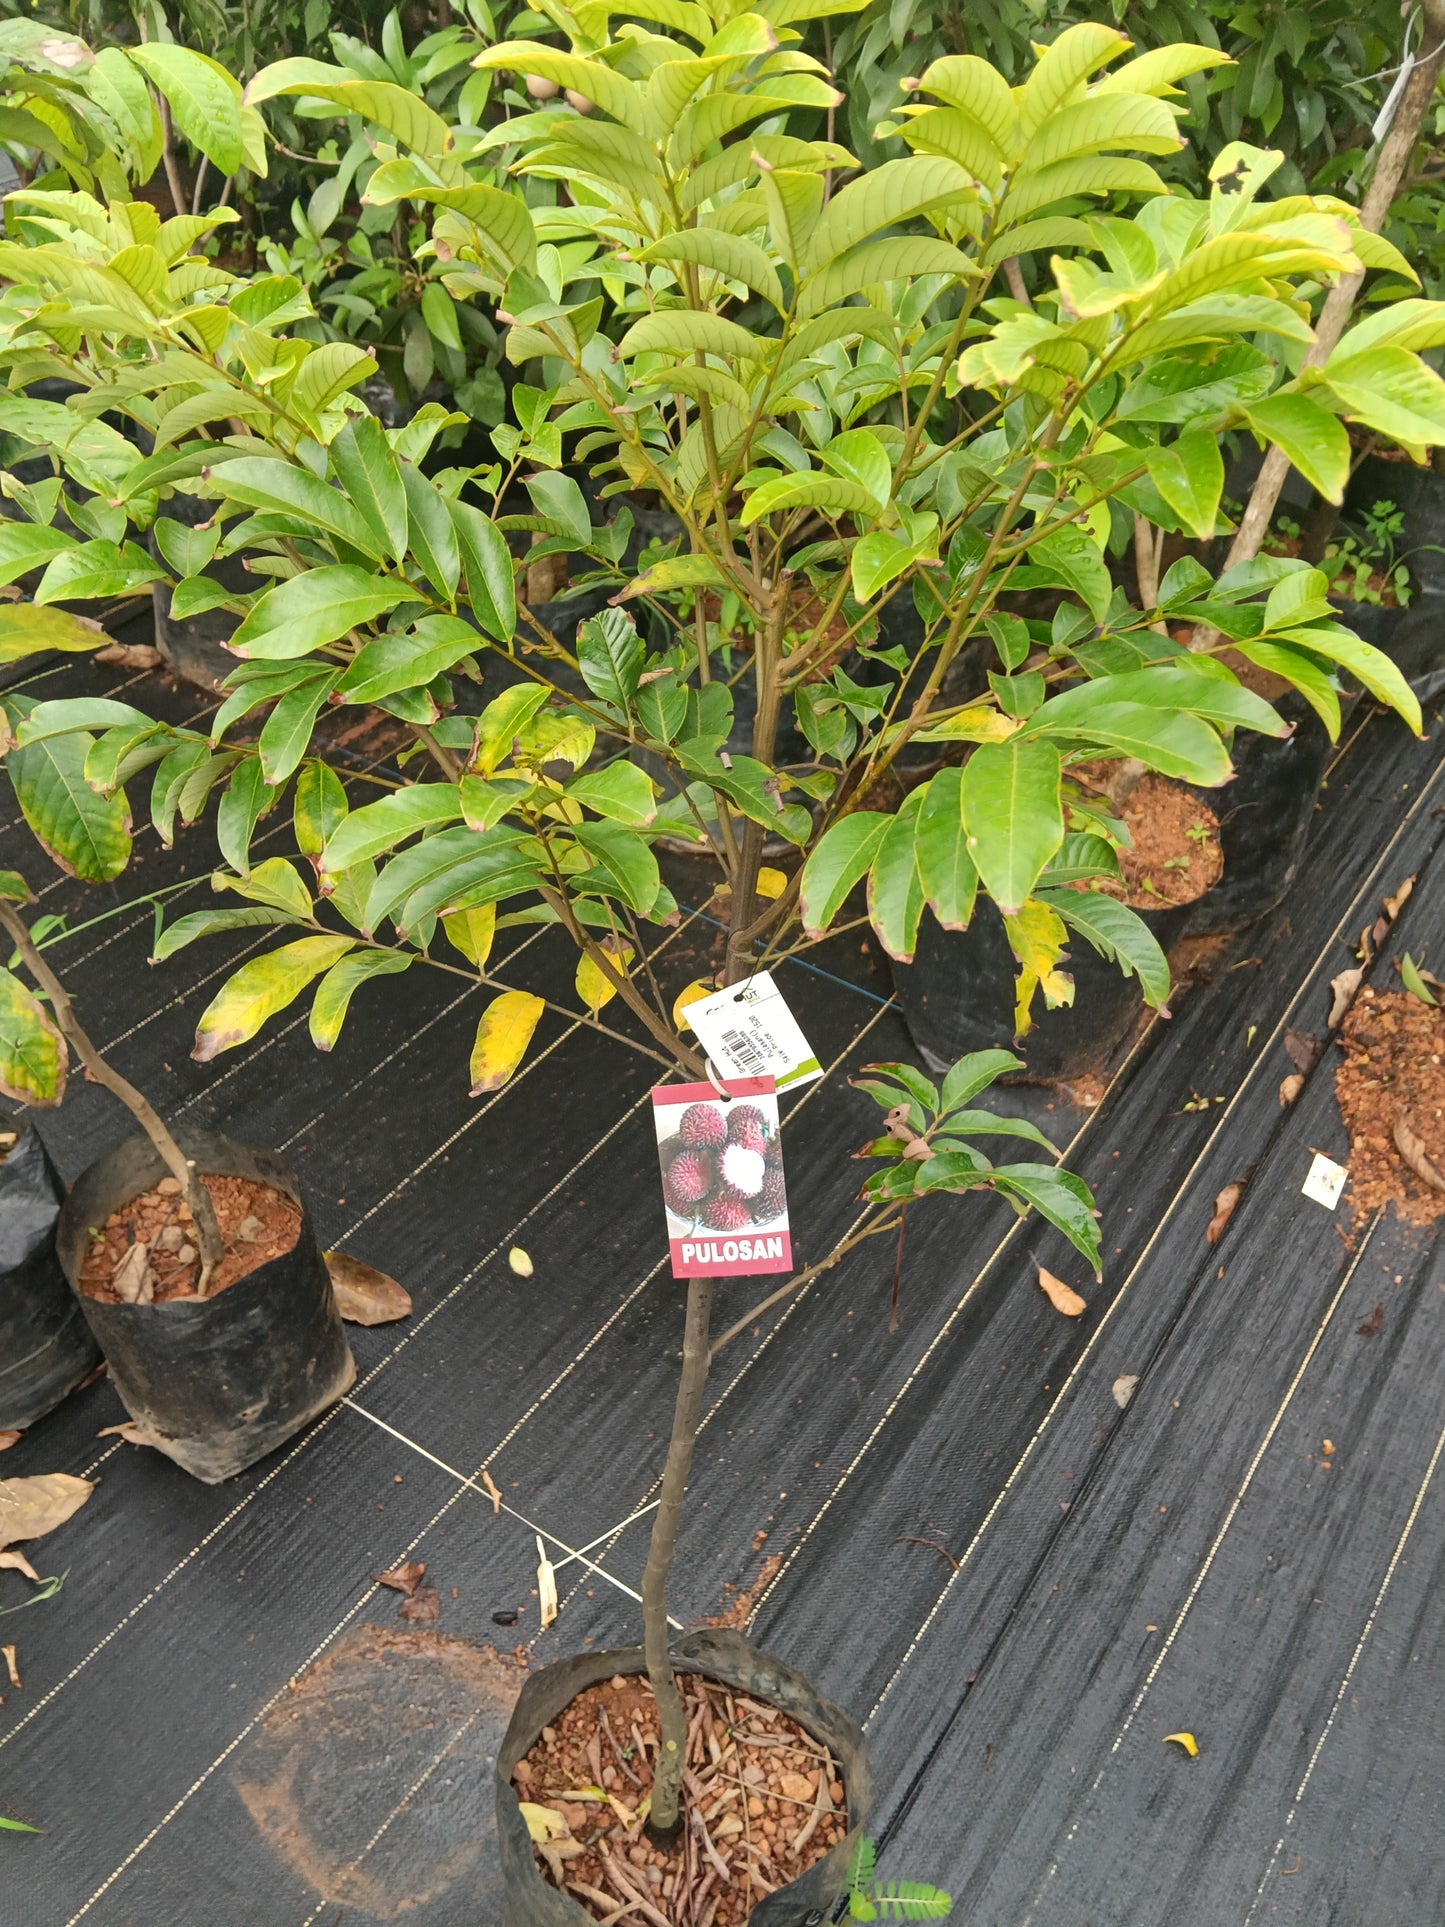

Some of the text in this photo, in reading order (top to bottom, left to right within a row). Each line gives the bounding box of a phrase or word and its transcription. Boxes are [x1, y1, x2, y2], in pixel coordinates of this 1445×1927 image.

[749, 1015, 762, 1029] 1520
[764, 1032, 778, 1049] Price
[731, 1058, 746, 1074] Green
[682, 1237, 783, 1264] PULOSAN
